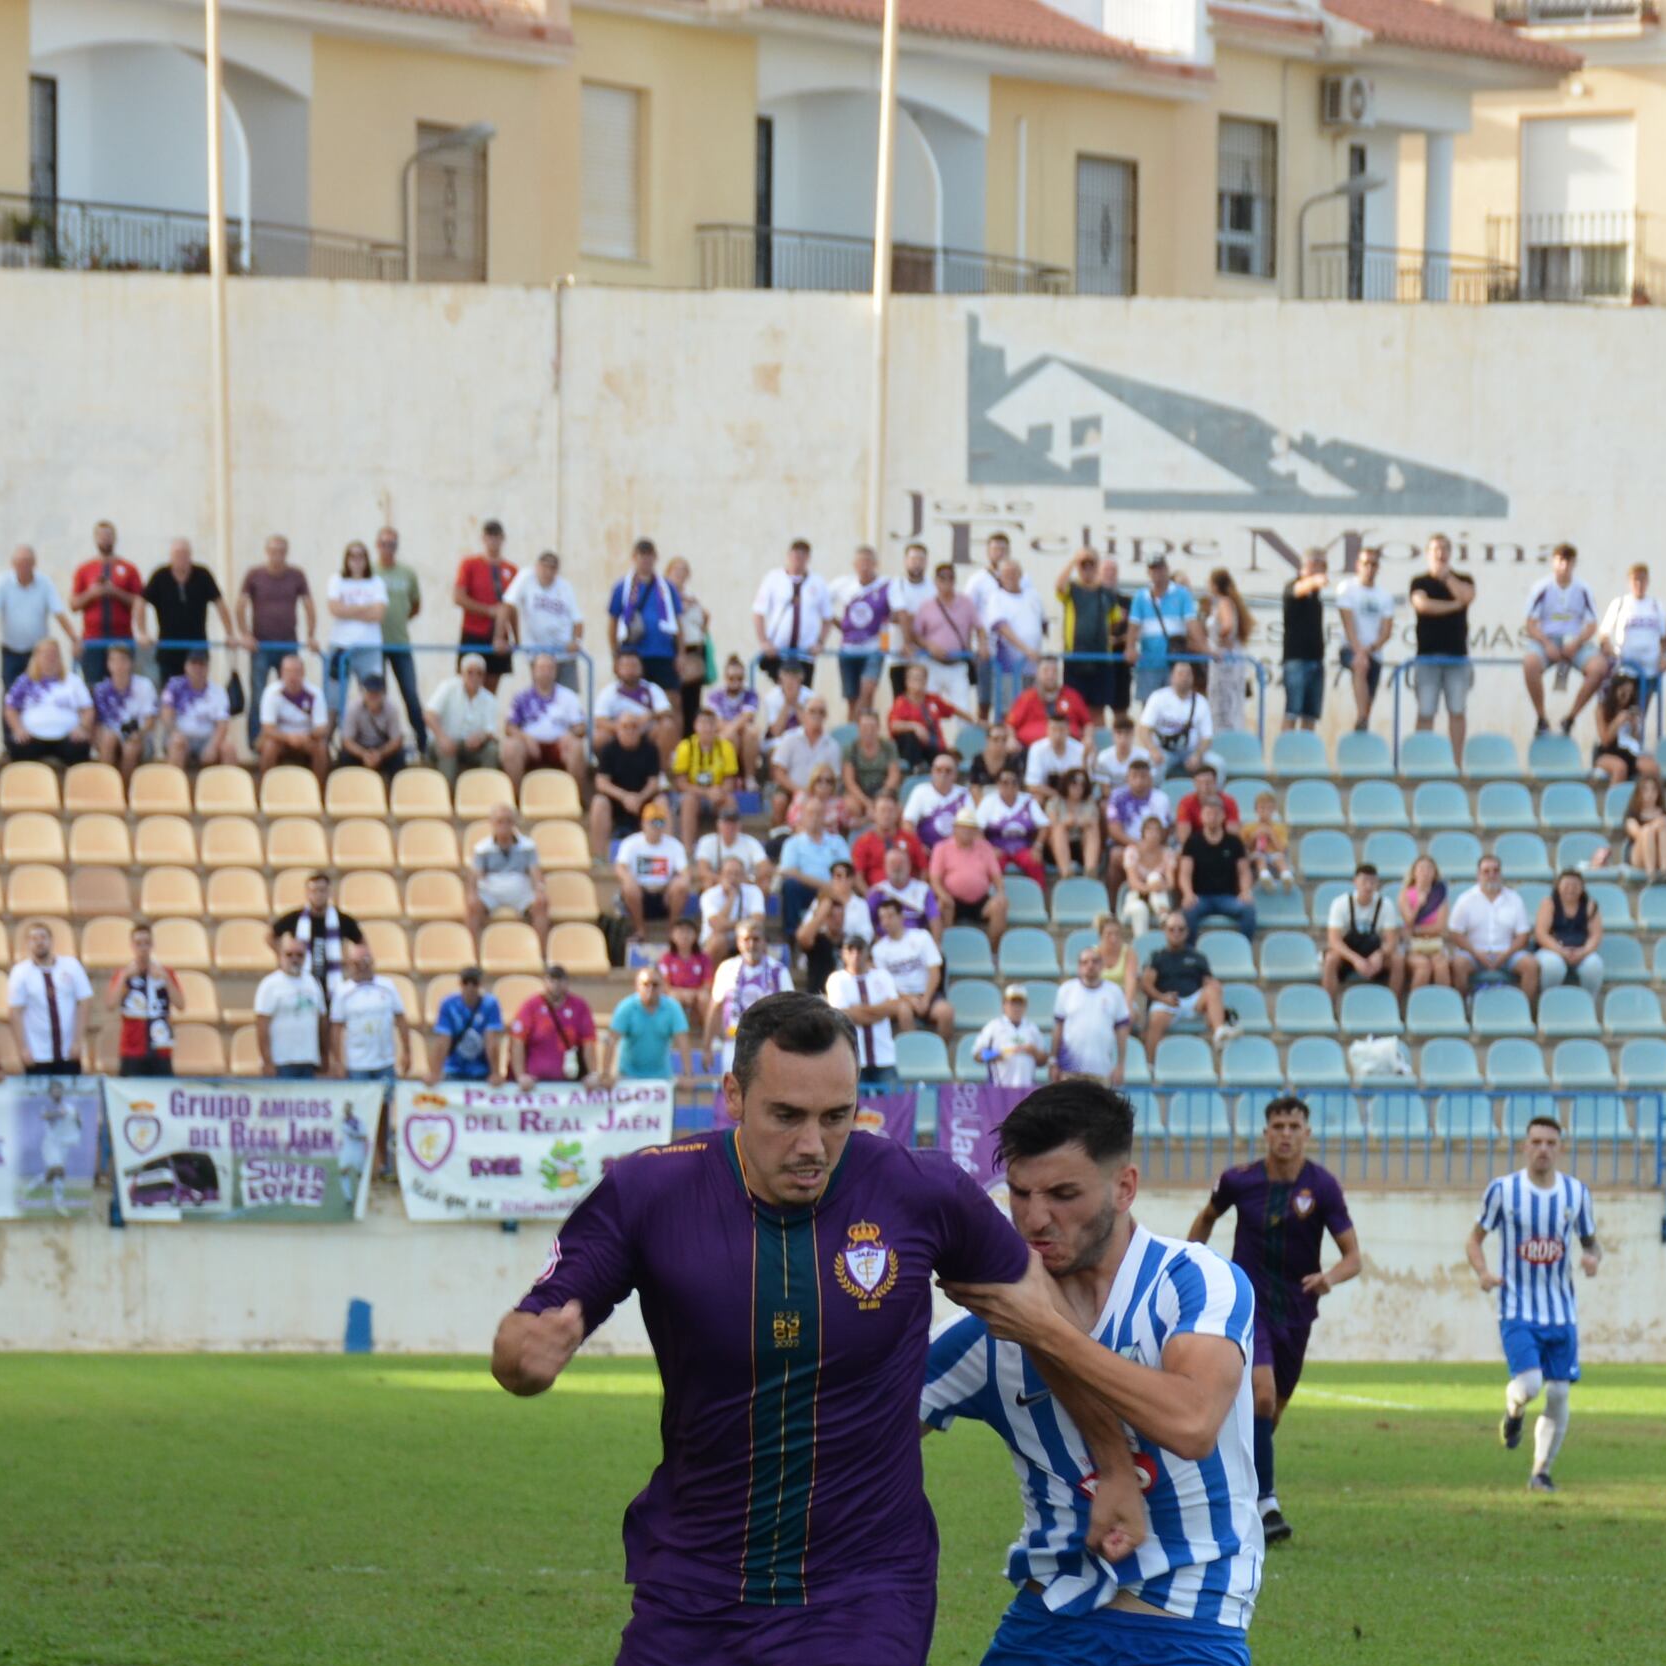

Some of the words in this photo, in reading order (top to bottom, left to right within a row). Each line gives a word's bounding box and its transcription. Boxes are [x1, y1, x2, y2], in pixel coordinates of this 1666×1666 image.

[258, 1100, 332, 1118] AMIGOS
[465, 1114, 508, 1131] DEL
[189, 1126, 220, 1147] DEL
[246, 1156, 326, 1180] SUPER
